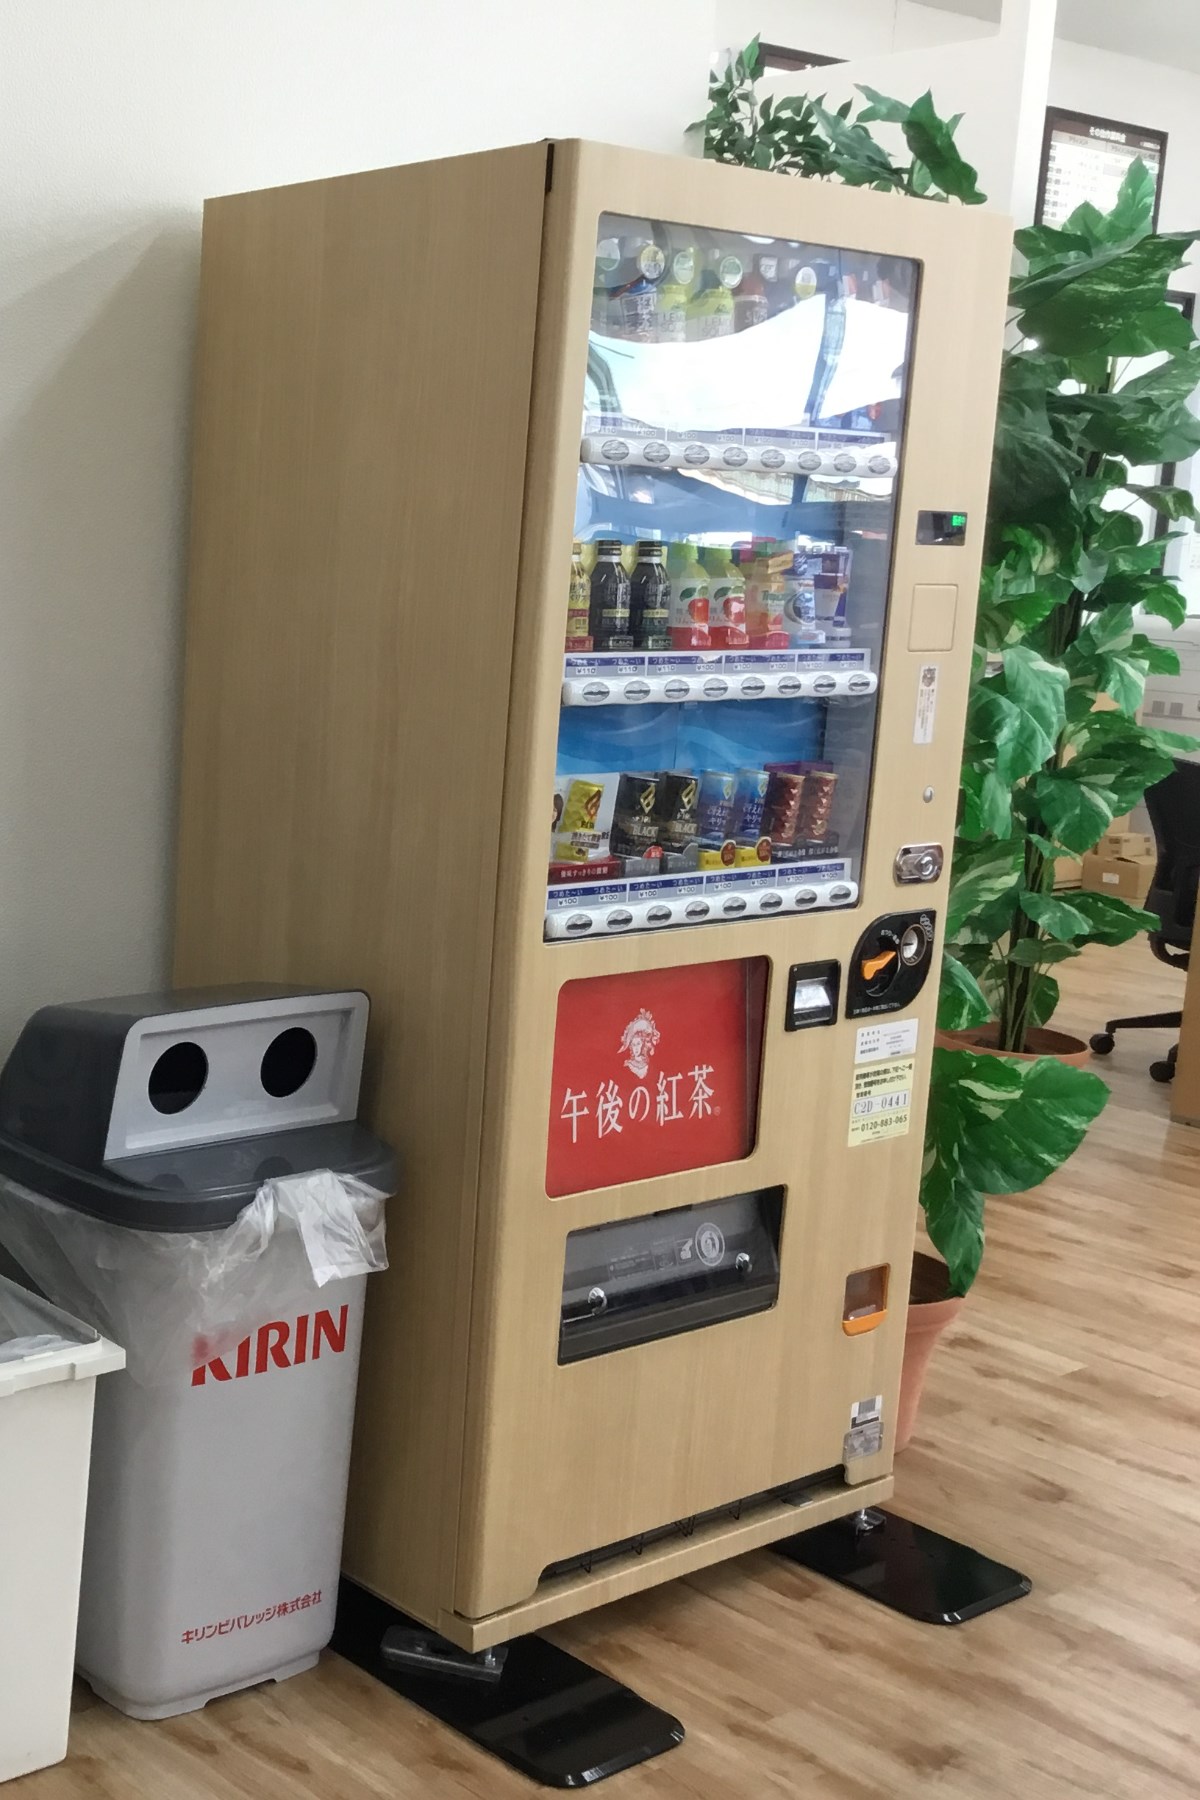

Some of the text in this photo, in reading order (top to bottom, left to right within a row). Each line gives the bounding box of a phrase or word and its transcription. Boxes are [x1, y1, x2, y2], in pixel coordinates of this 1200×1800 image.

[632, 824, 657, 836] BLACK
[675, 821, 697, 833] BLACK
[639, 890, 658, 898] ¥100
[678, 886, 696, 894] ¥100
[558, 897, 578, 906] ¥100
[560, 1064, 715, 1144] 午後の紅茶
[191, 1303, 349, 1387] KIRIN
[181, 1589, 323, 1644] キリンビバレッジ株式会社
